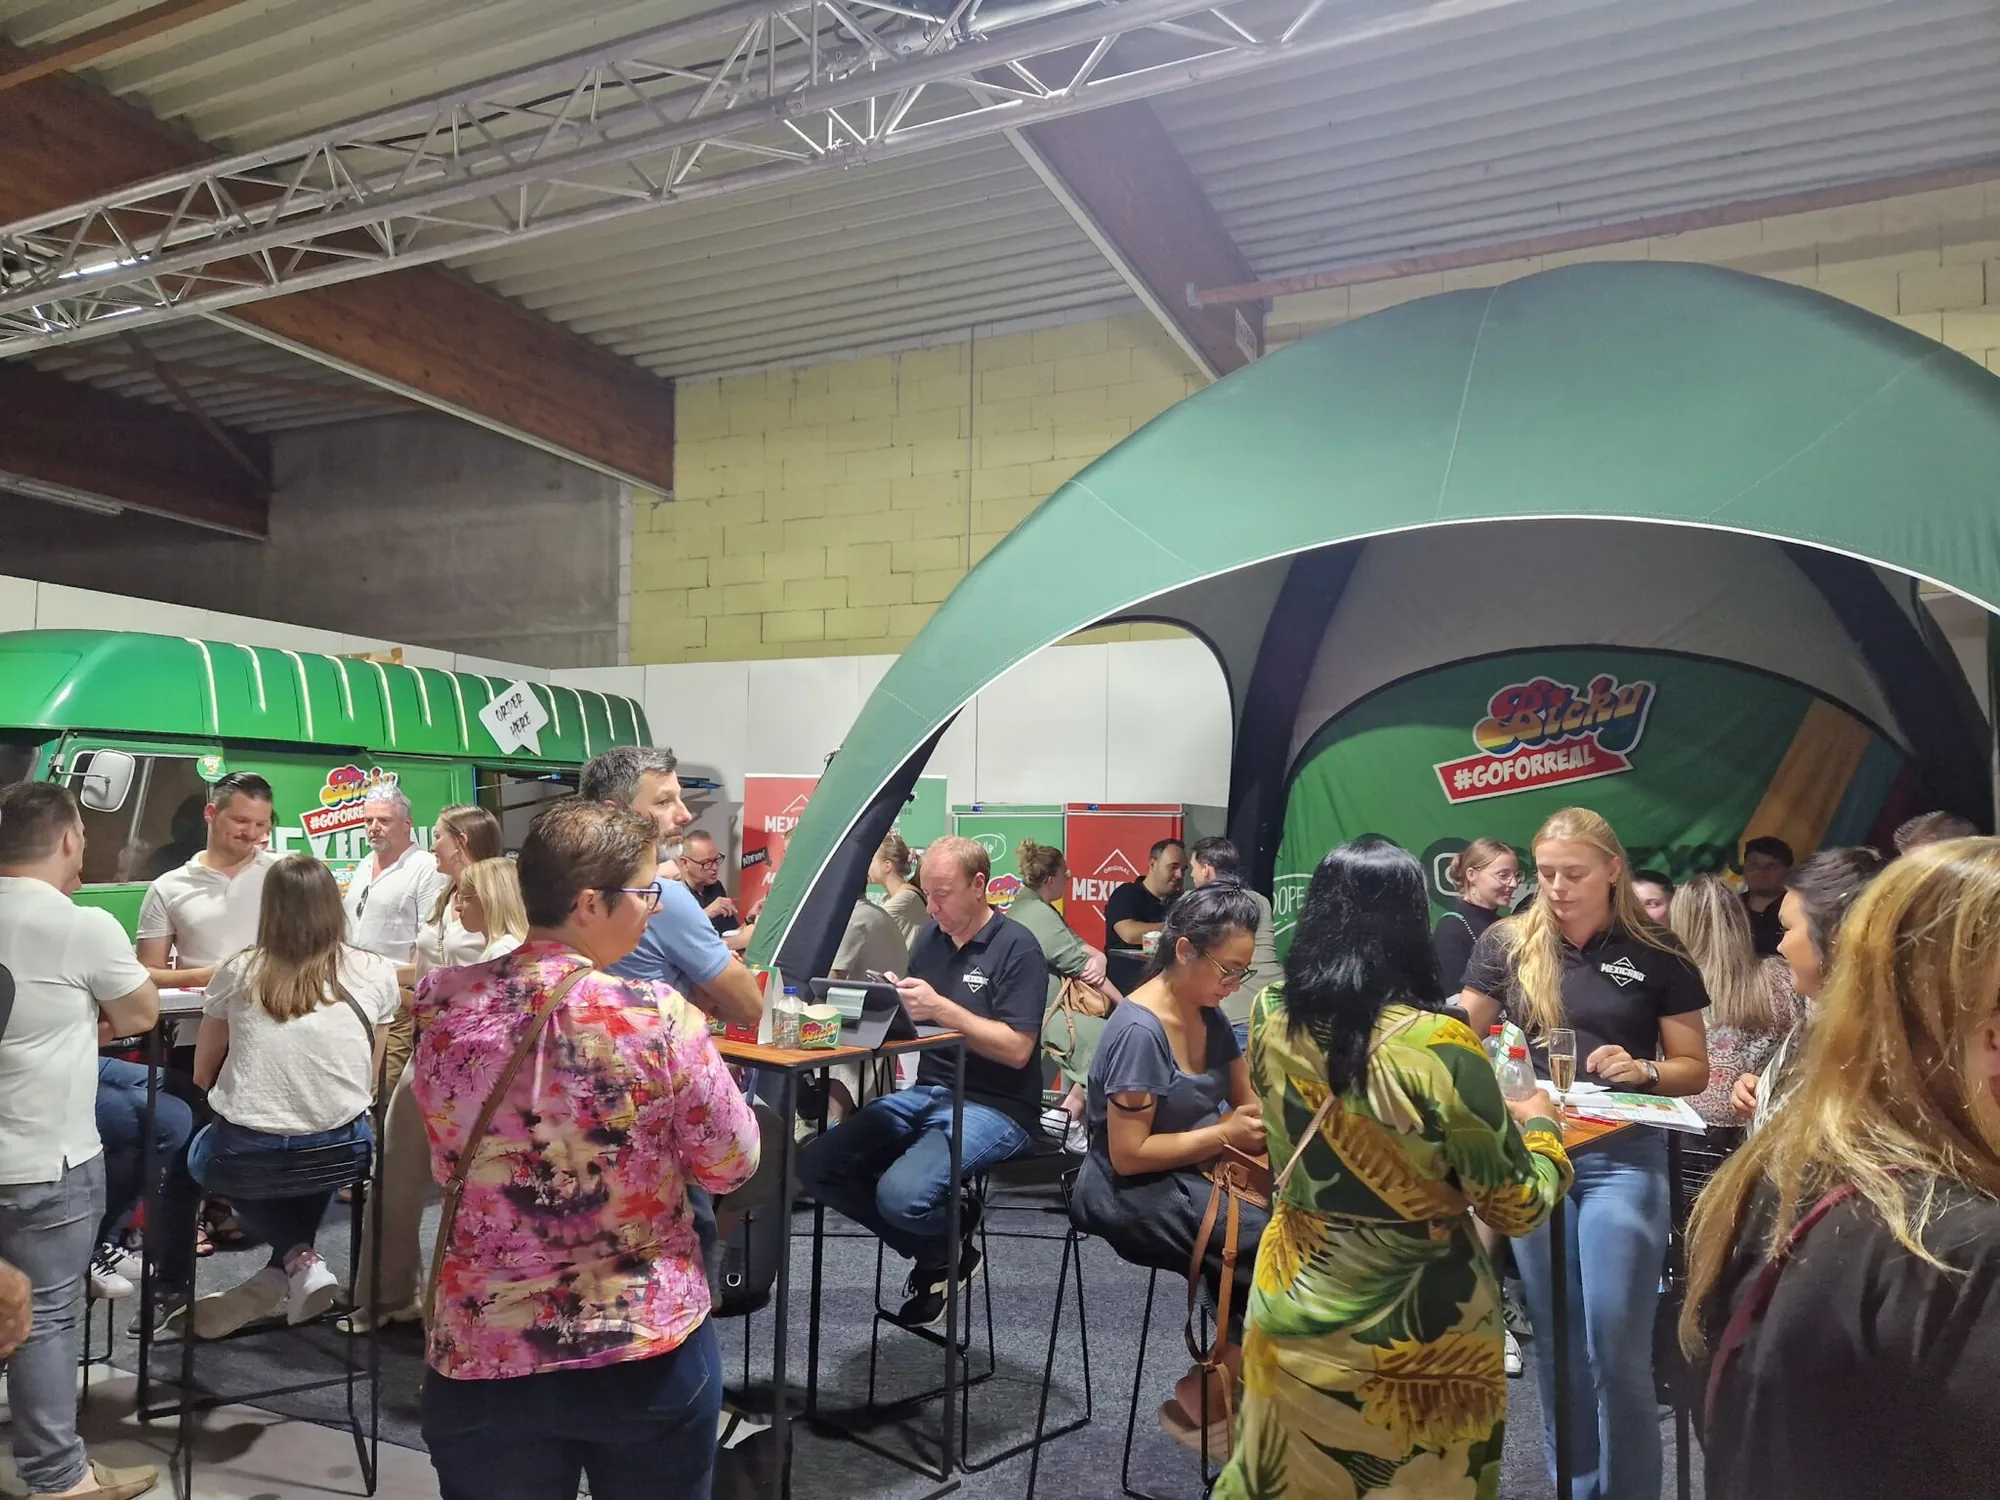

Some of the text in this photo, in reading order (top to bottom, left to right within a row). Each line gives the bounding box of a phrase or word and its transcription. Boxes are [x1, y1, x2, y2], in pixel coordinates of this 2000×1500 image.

[495, 693, 524, 721] ORDER
[1474, 675, 1653, 756] Bicky
[510, 712, 531, 740] HERE
[1453, 744, 1595, 790] #GOFORREAL
[309, 805, 365, 830] #GOFORRE
[1600, 962, 1646, 982] MEXICANO
